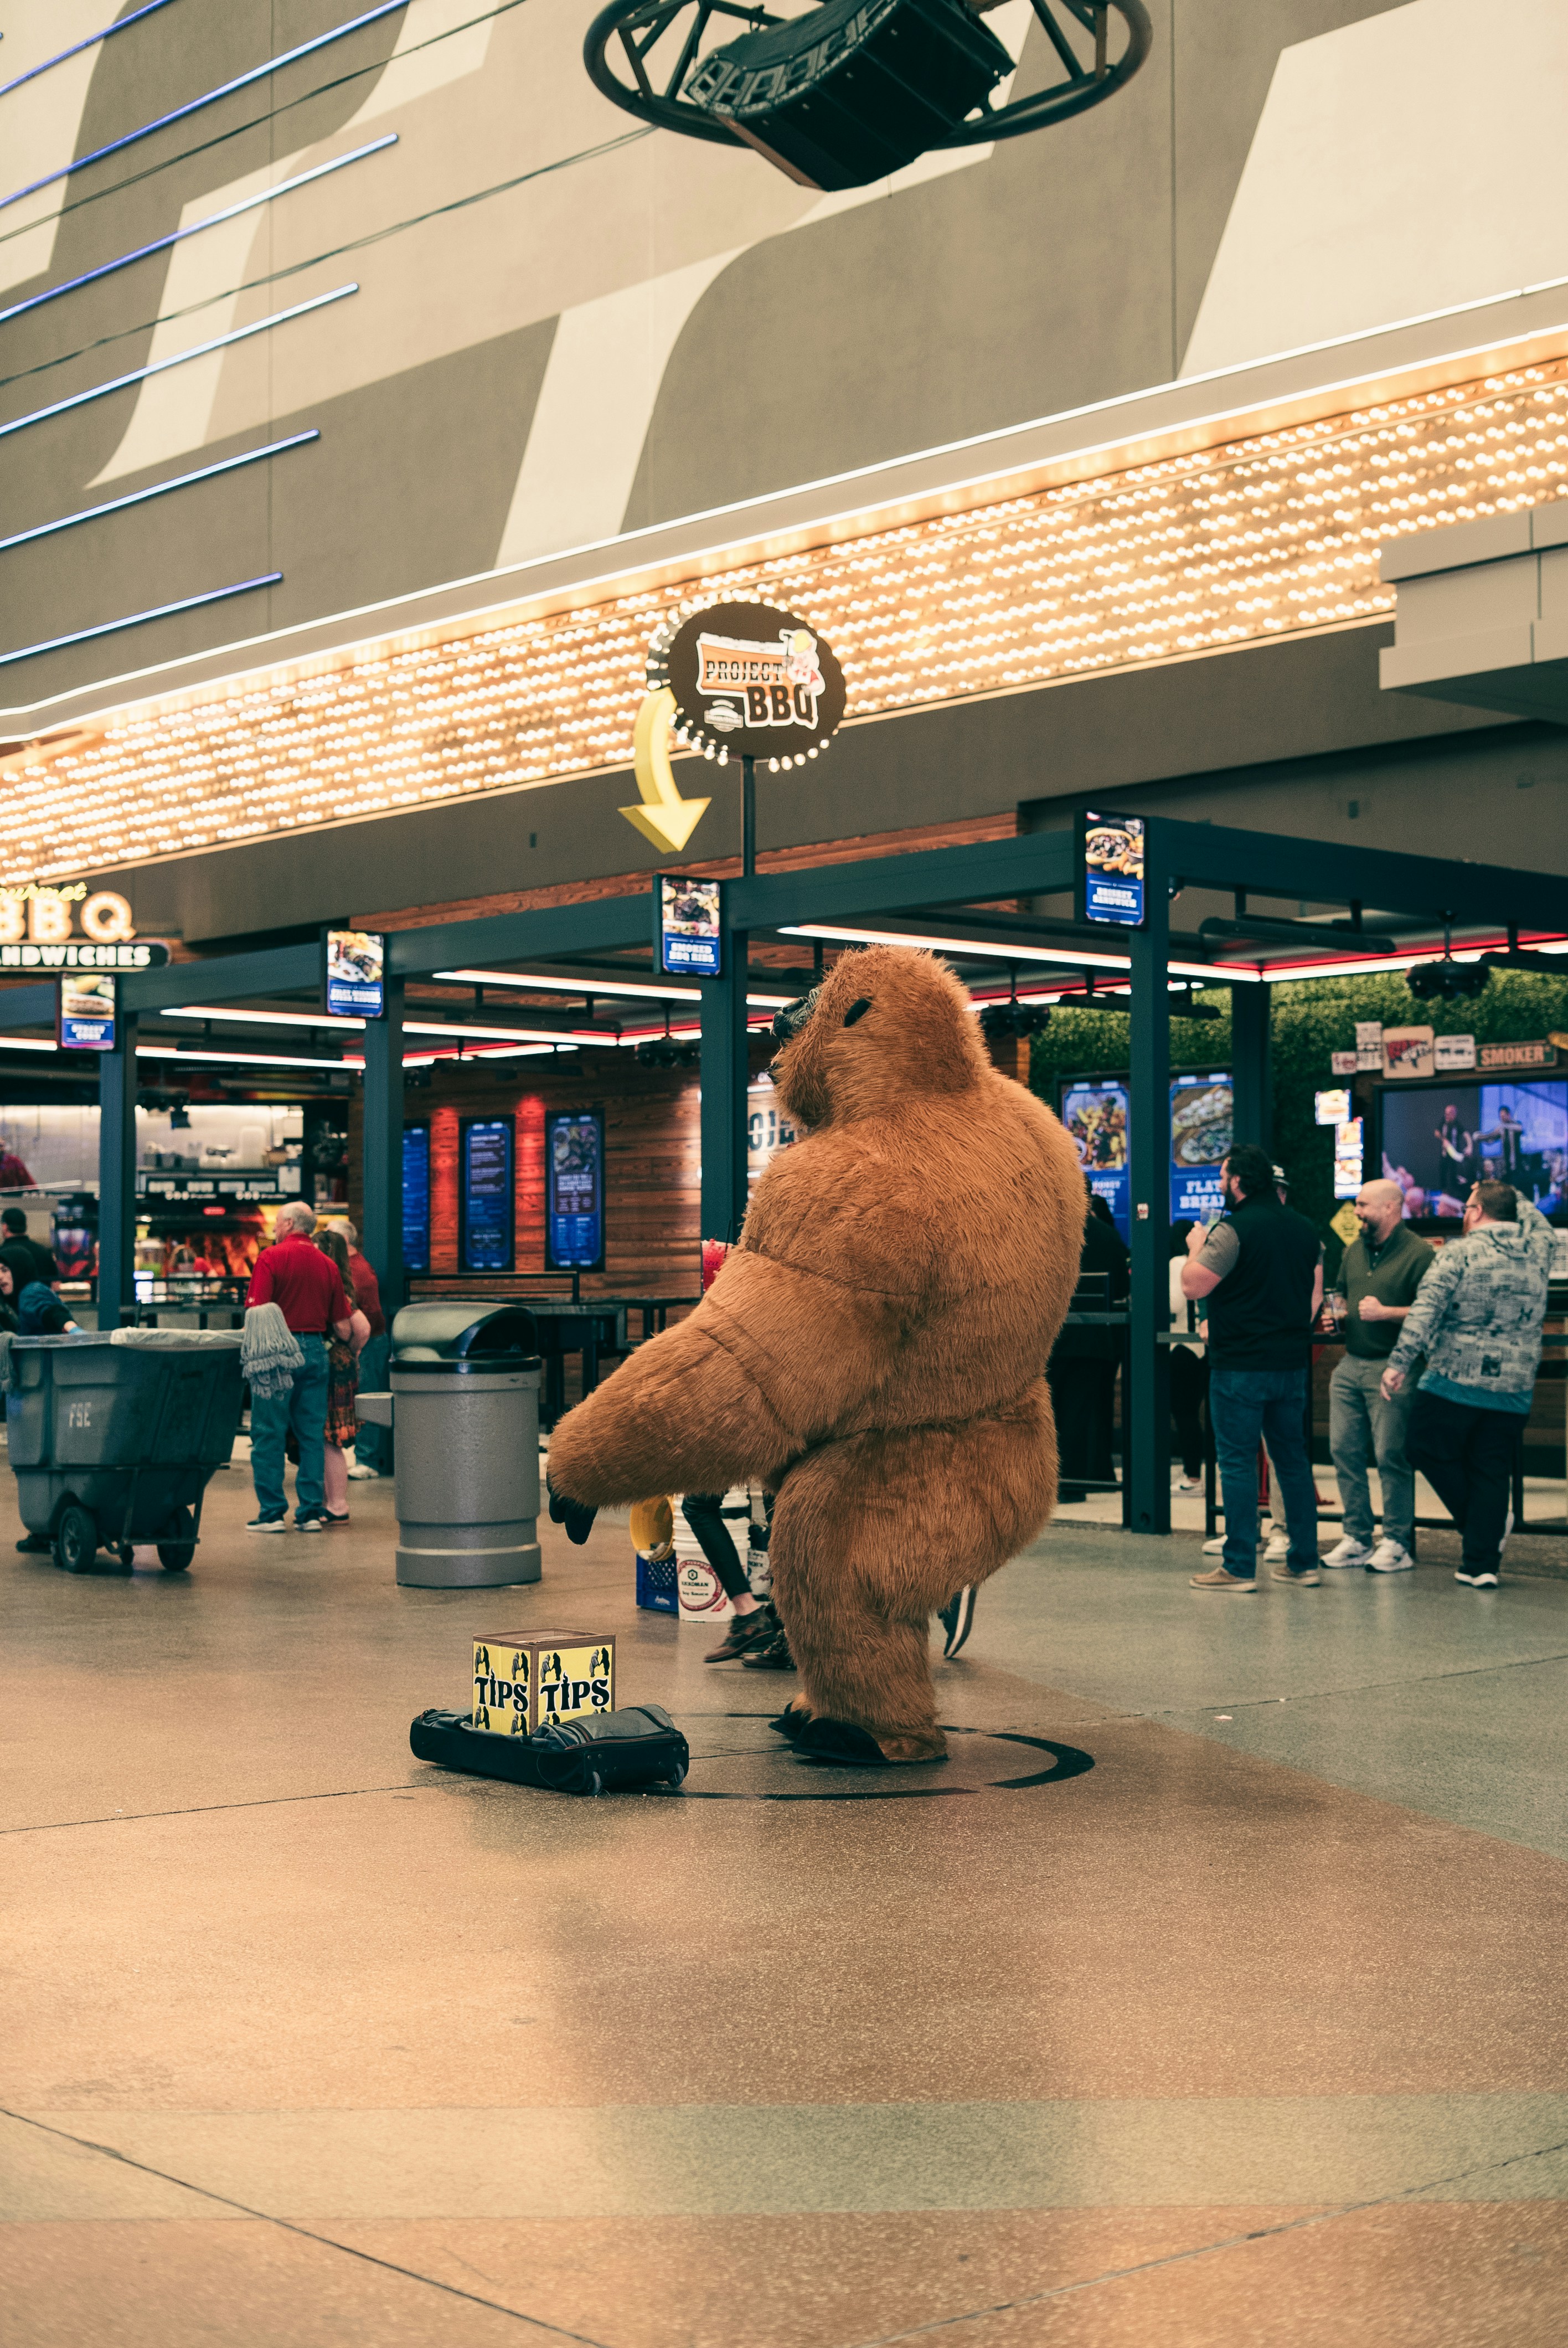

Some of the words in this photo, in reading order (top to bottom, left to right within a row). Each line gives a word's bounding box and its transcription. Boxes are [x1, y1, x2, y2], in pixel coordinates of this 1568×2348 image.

[706, 660, 785, 683] PROJECT
[746, 683, 814, 724] BBQ
[0, 891, 137, 944] BBQ
[0, 946, 151, 966] NDWICHES
[1481, 1045, 1544, 1066] SMOKER
[474, 1668, 529, 1712] TIPS
[540, 1671, 610, 1712] TIPS
